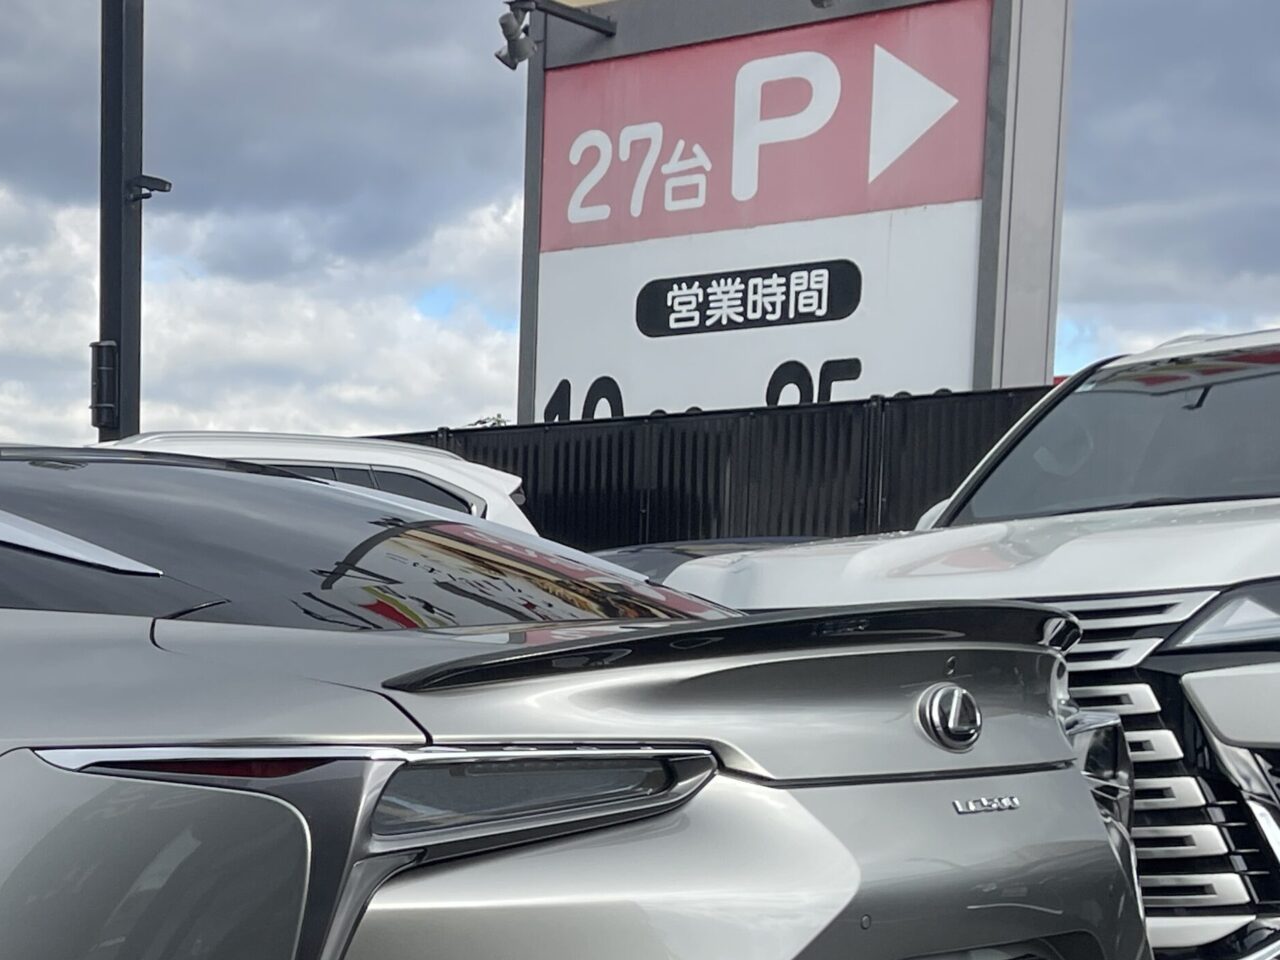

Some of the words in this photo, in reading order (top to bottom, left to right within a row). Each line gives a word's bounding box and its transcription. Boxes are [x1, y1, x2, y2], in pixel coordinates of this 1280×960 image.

[731, 50, 842, 202] P
[666, 268, 830, 329] 営業時間
